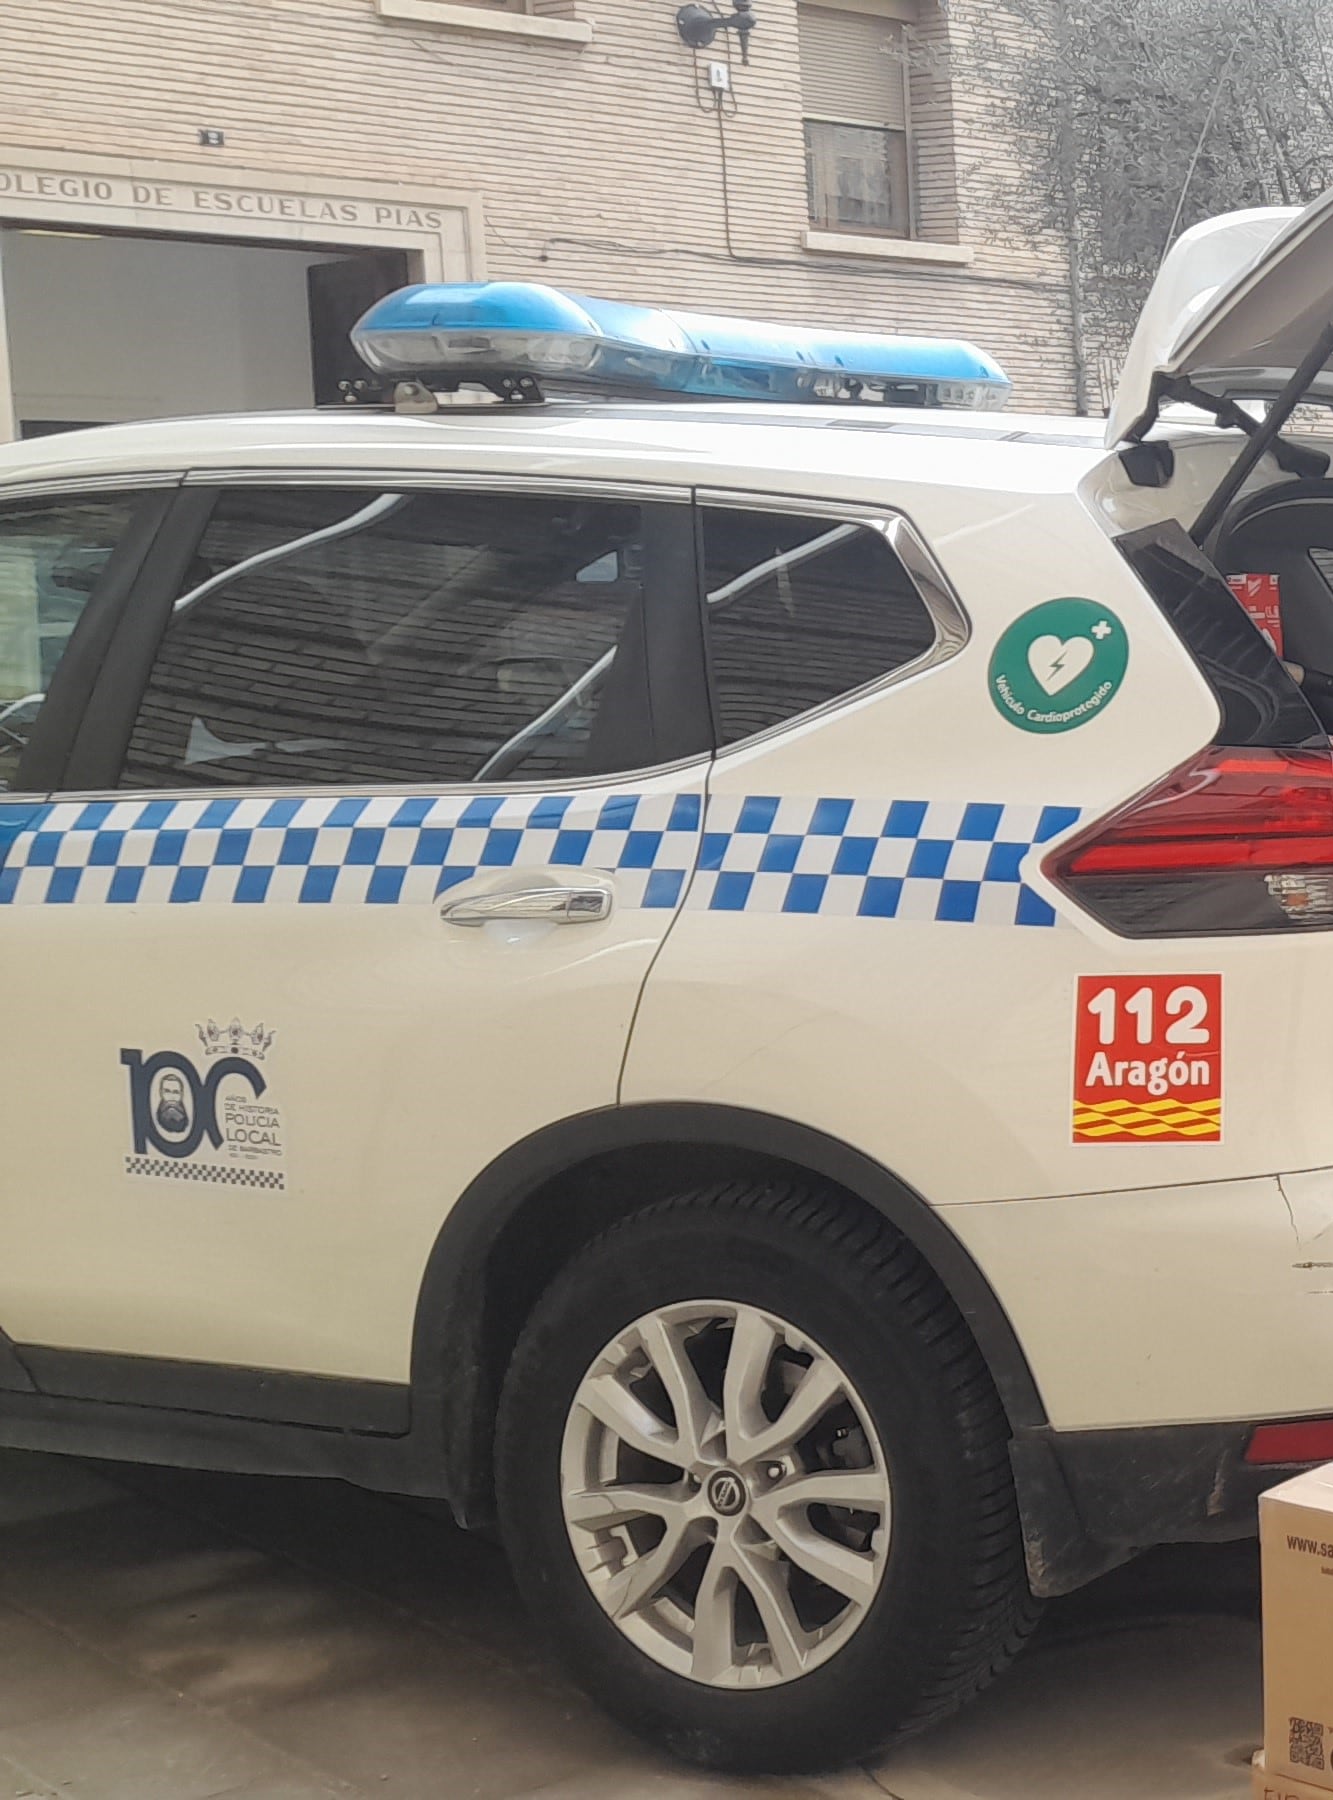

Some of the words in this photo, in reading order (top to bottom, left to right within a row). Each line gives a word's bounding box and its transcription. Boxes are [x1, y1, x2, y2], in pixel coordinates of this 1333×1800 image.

[131, 185, 173, 206] DE
[193, 190, 358, 222] ESCUELAS
[375, 206, 442, 229] PIAS
[1088, 986, 1210, 1045] 112
[1085, 1051, 1210, 1096] Aragón
[225, 1113, 280, 1128] POLICIA
[226, 1128, 281, 1146] LOCAL
